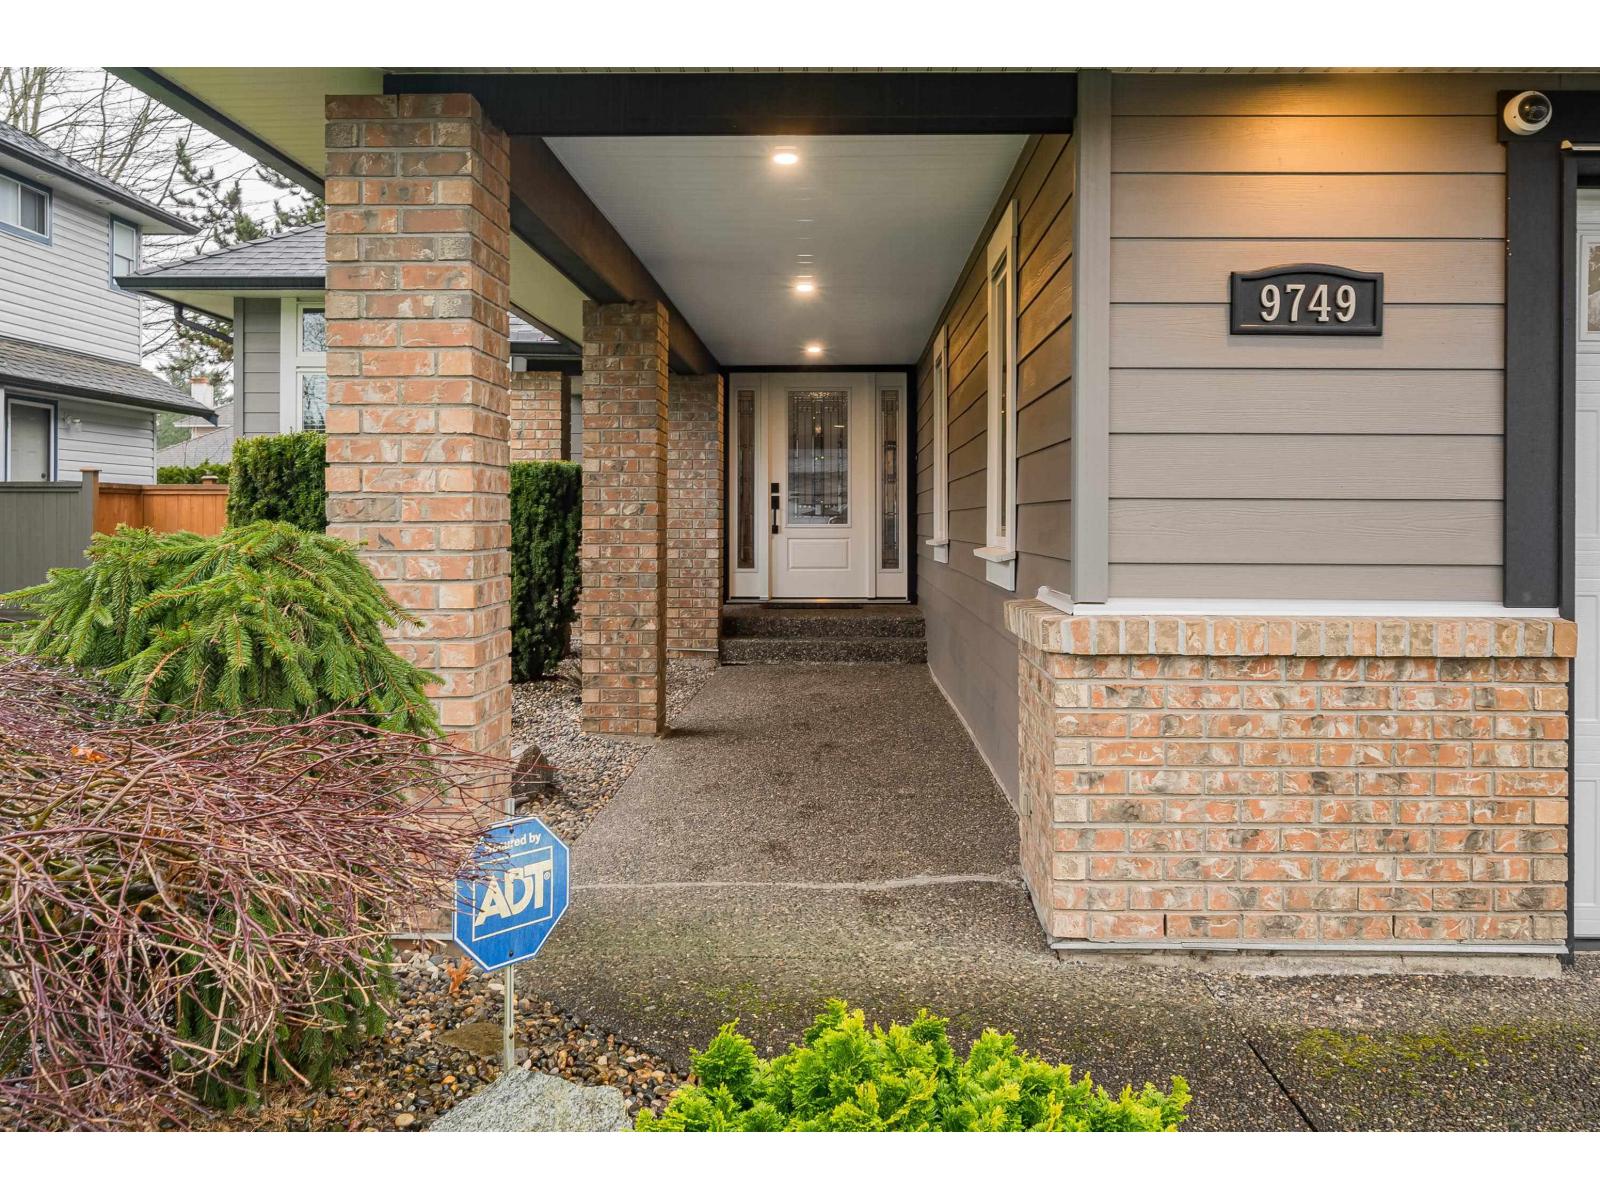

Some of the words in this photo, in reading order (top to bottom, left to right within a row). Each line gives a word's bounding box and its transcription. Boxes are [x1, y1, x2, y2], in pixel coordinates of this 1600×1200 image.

[1260, 284, 1356, 322] 9749
[485, 833, 527, 852] cured
[528, 832, 542, 845] by
[474, 859, 551, 927] ADT
